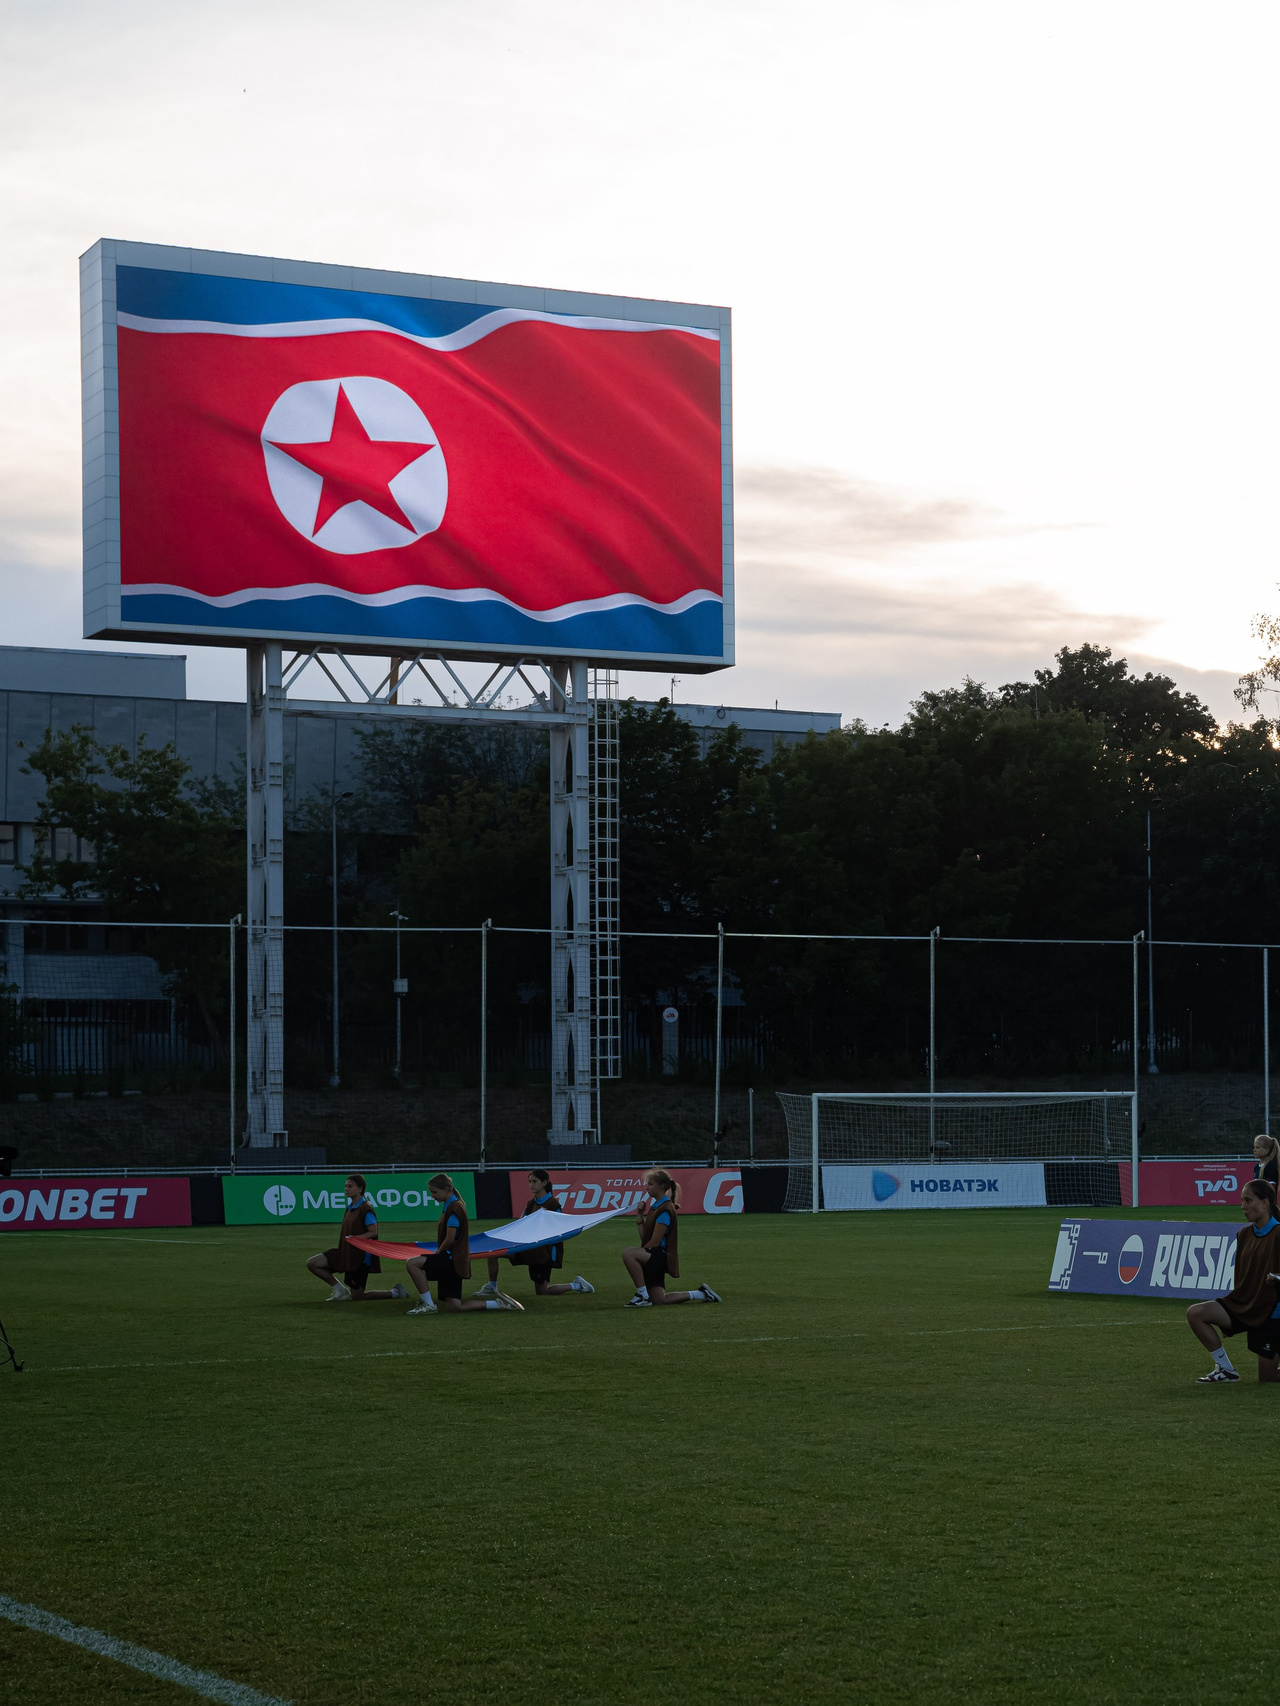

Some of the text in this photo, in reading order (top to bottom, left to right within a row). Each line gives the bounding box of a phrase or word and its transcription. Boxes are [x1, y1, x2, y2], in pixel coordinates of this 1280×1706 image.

[606, 1179, 648, 1187] ТОПЛИ
[910, 1179, 999, 1193] НОВАТЭК
[0, 1187, 148, 1222] ONBET
[303, 1188, 440, 1209] МЕАФОН
